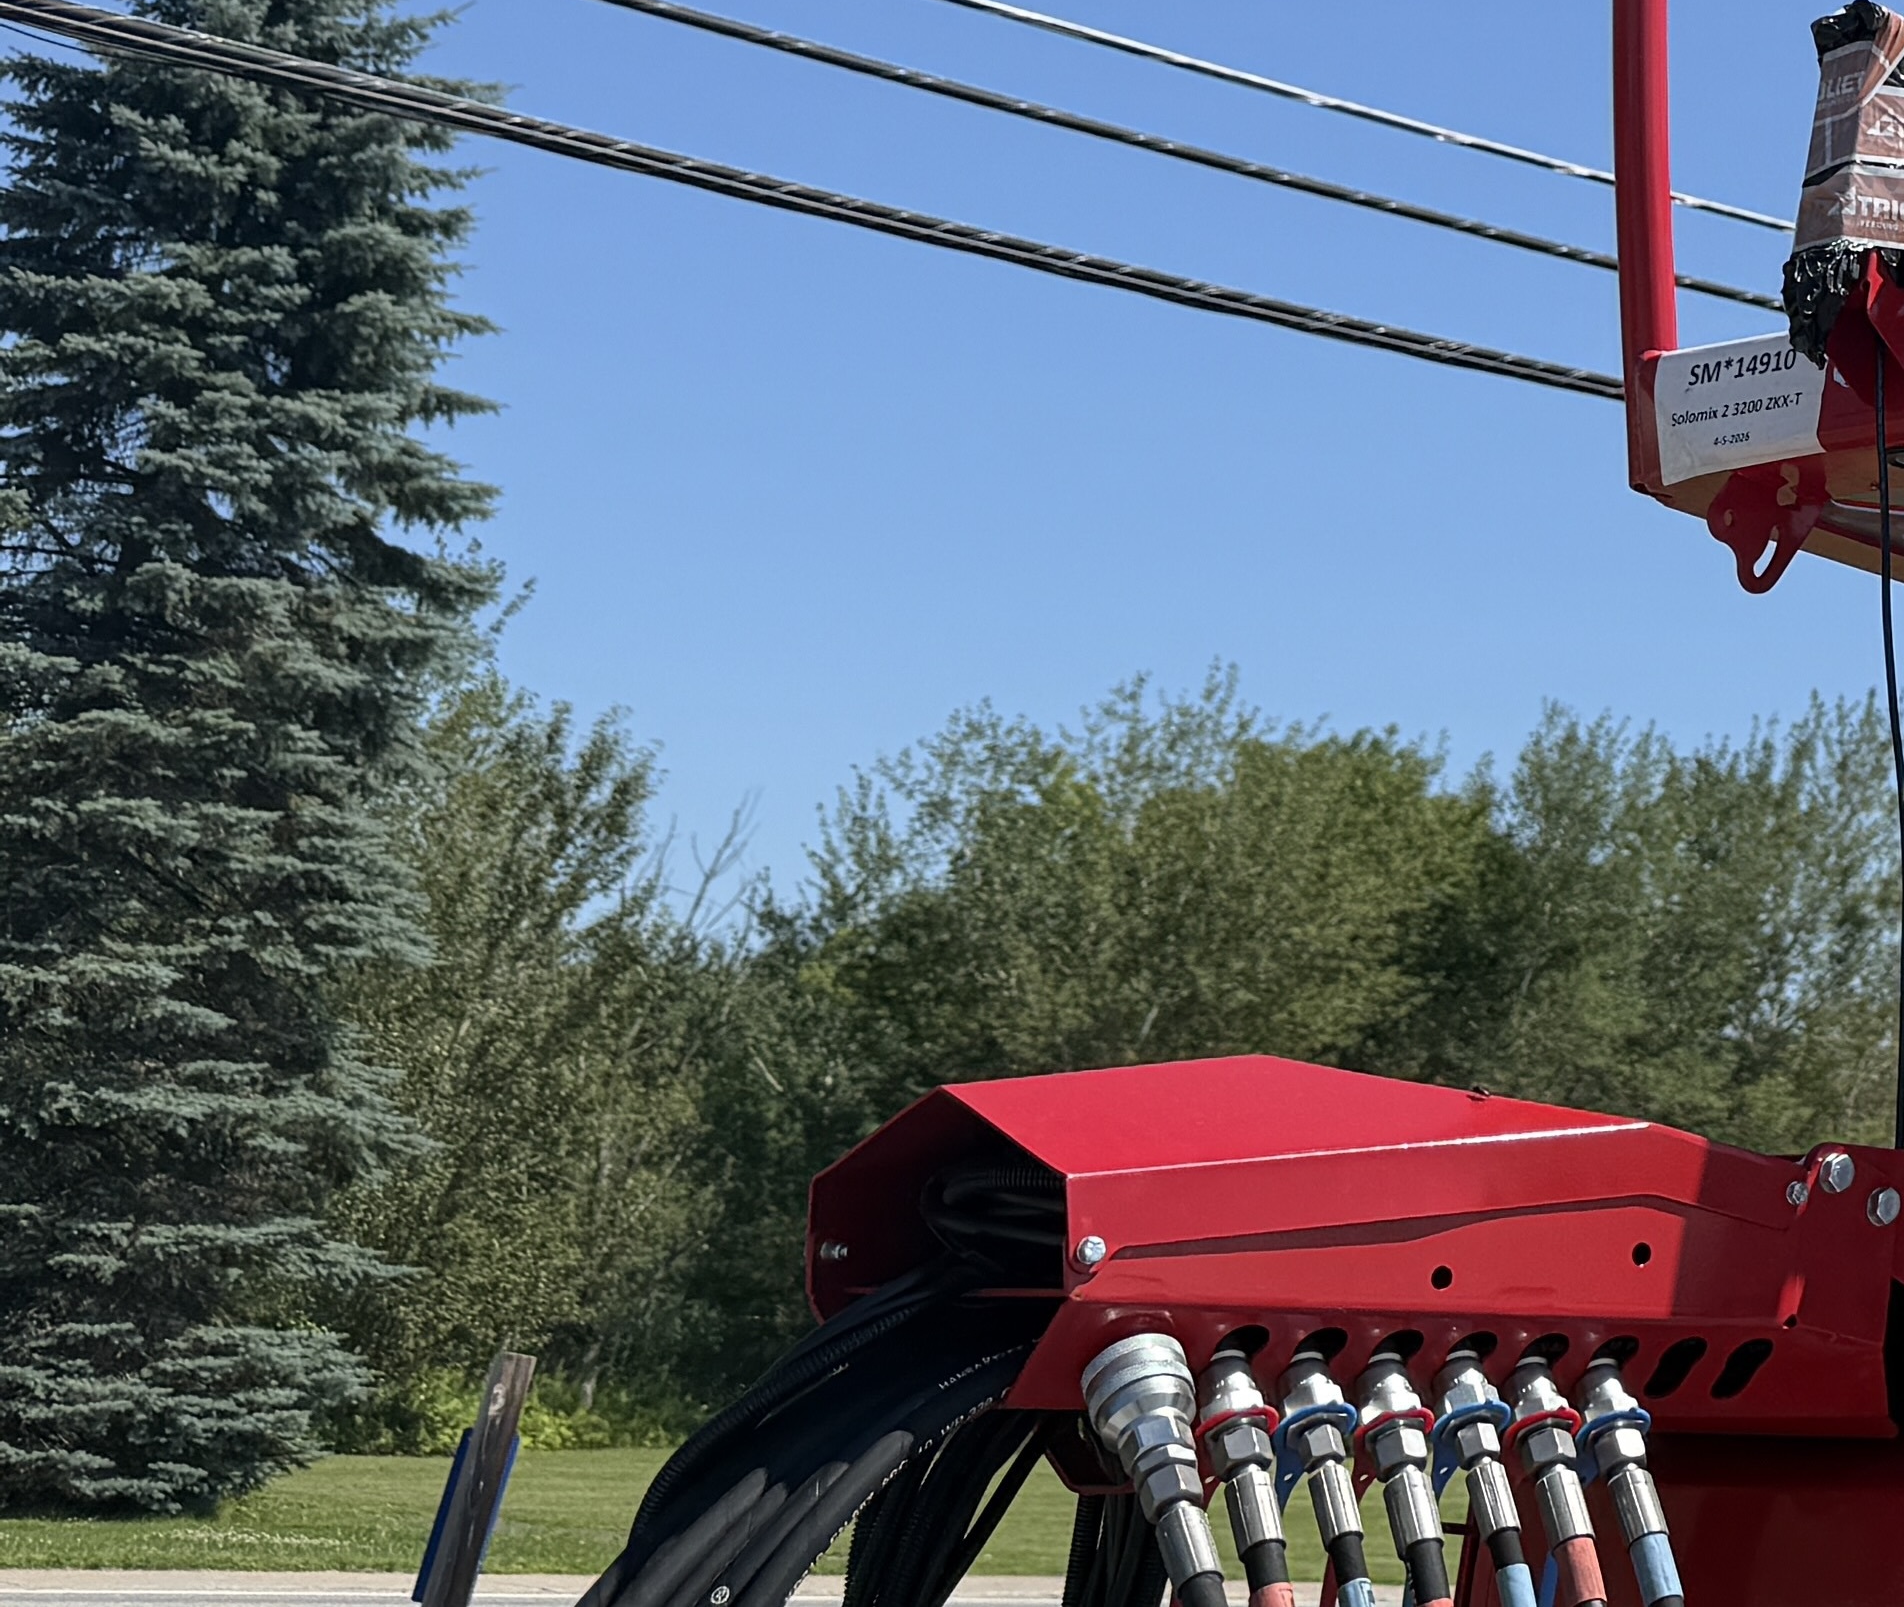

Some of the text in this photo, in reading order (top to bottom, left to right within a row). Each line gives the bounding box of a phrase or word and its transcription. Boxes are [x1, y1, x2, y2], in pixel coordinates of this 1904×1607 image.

[1671, 391, 1803, 427] Solomix 2 3200 ZKX-T
